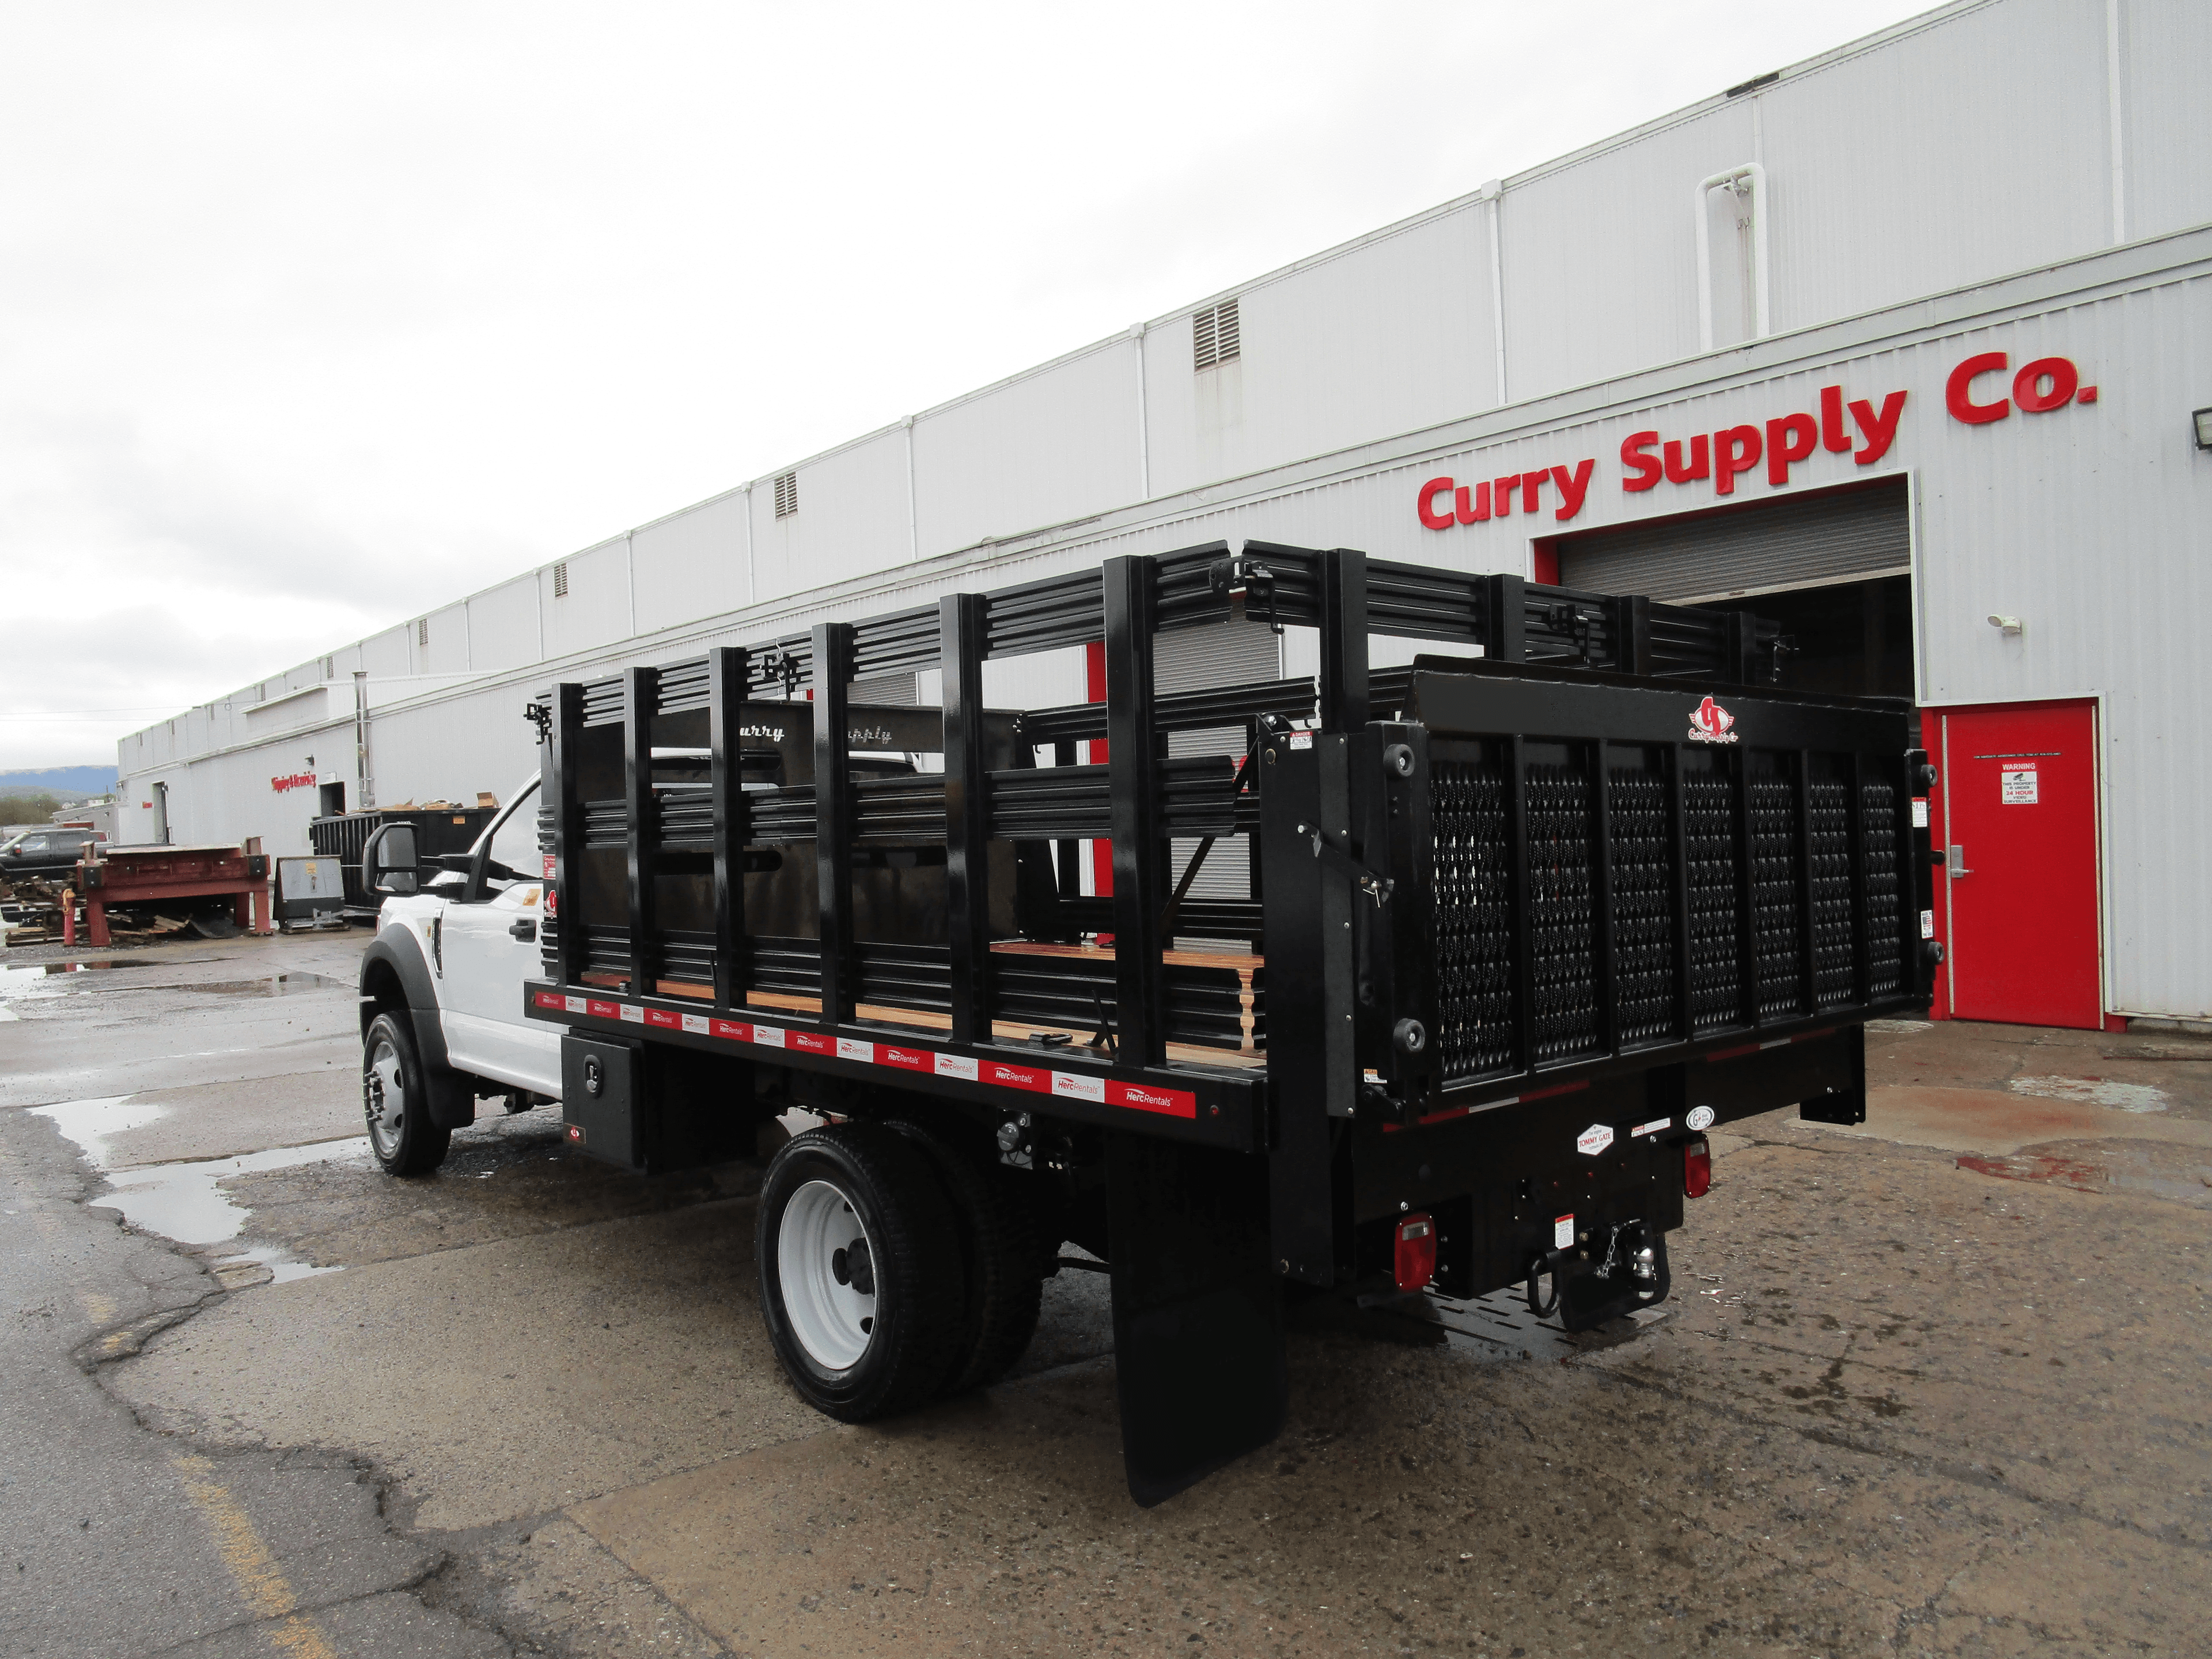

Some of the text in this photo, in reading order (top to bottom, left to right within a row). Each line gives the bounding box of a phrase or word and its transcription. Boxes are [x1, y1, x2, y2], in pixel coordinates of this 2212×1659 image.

[1418, 352, 2097, 530] Curry Supply Co.
[740, 725, 785, 742] urry
[1579, 1132, 1611, 1147] TOMMY GATE
